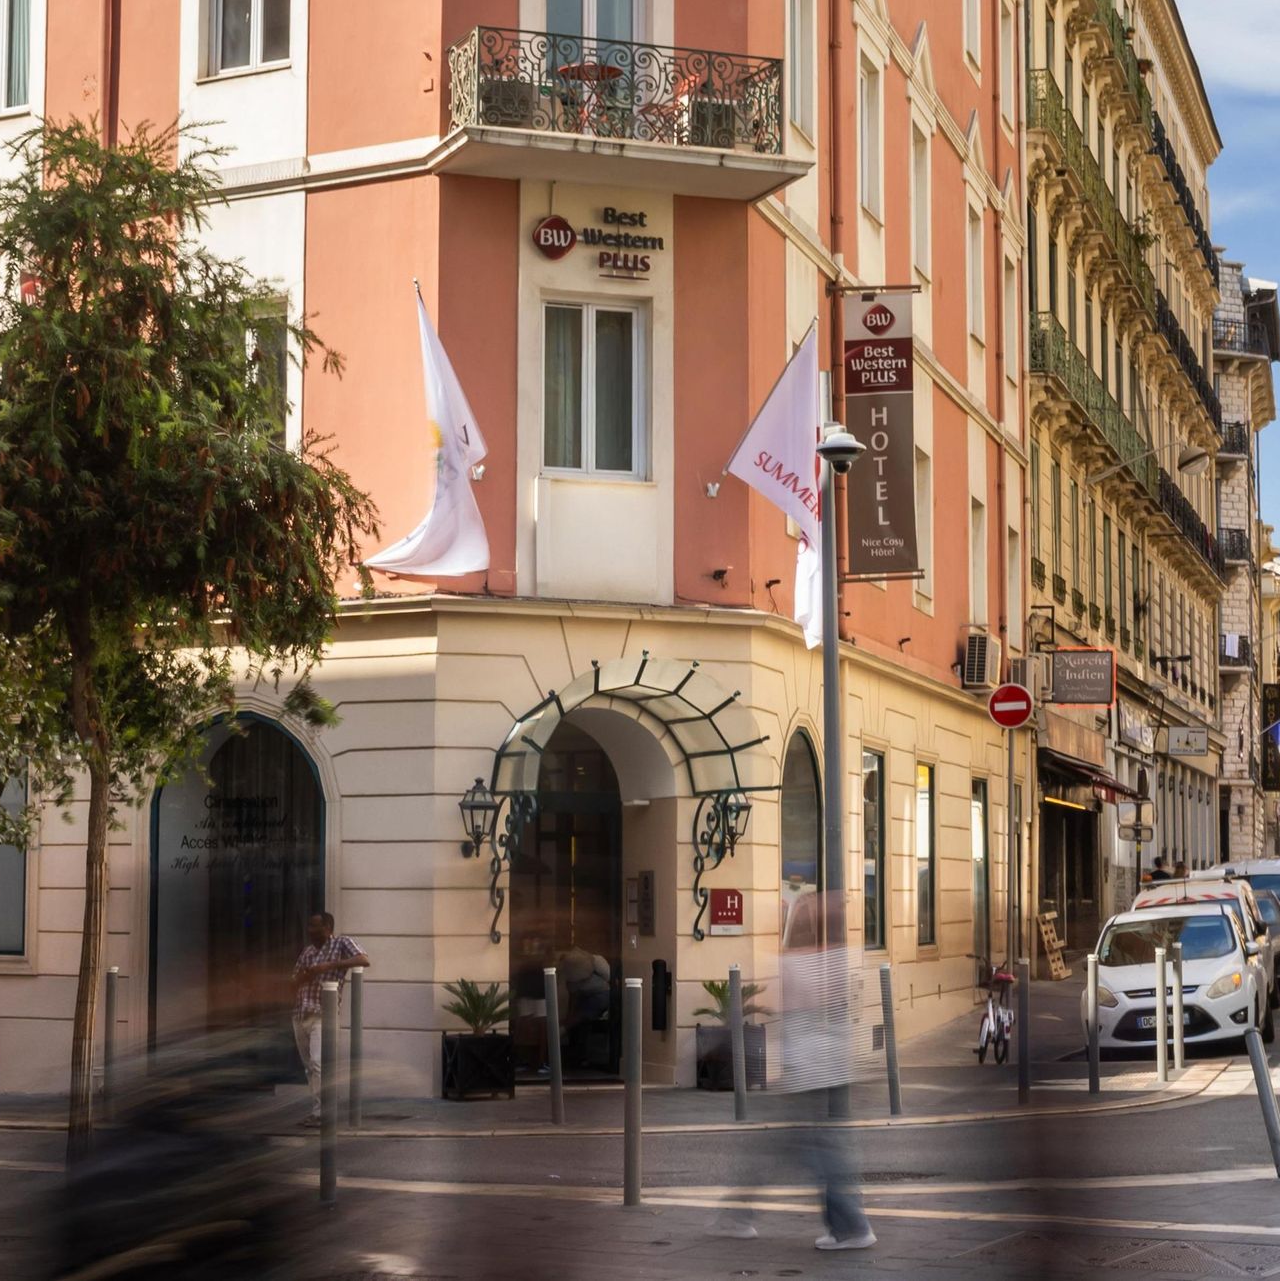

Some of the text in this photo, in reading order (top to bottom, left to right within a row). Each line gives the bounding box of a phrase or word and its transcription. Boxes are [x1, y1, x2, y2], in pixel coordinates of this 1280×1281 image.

[603, 207, 647, 227] Best
[540, 228, 571, 247] BW
[583, 228, 664, 250] Western
[599, 251, 650, 272] PLUS
[866, 313, 891, 327] BW
[864, 346, 894, 358] Best
[851, 358, 907, 371] Western
[861, 370, 897, 384] PLUS
[871, 406, 890, 526] HOTEL
[862, 537, 904, 549] Nice Cosy
[871, 547, 895, 557] Hôtel
[1059, 669, 1105, 681] Indien
[727, 895, 739, 909] H
